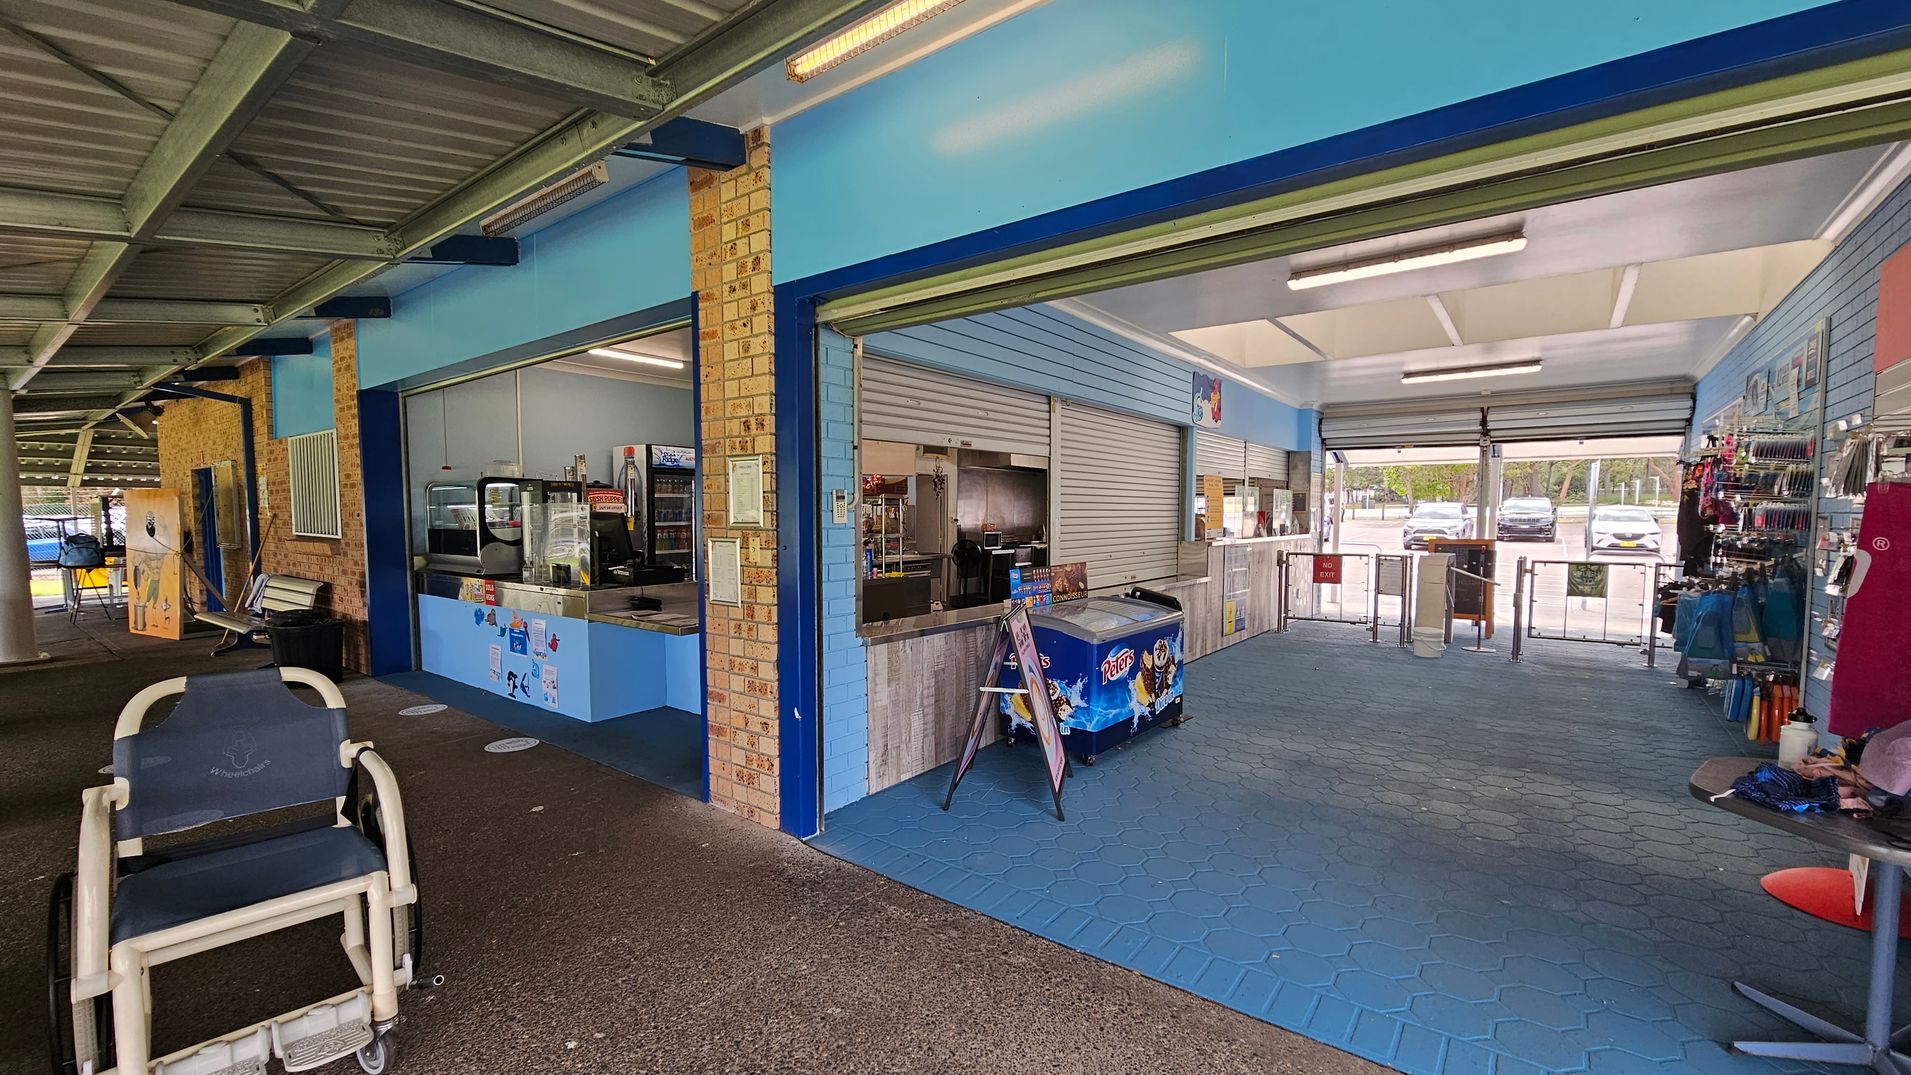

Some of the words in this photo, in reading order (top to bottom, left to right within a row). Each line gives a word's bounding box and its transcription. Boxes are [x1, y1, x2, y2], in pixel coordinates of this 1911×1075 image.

[1052, 590, 1088, 603] CONNOISSEUR
[1102, 649, 1134, 684] Peters
[210, 759, 271, 778] Wheelchairs
